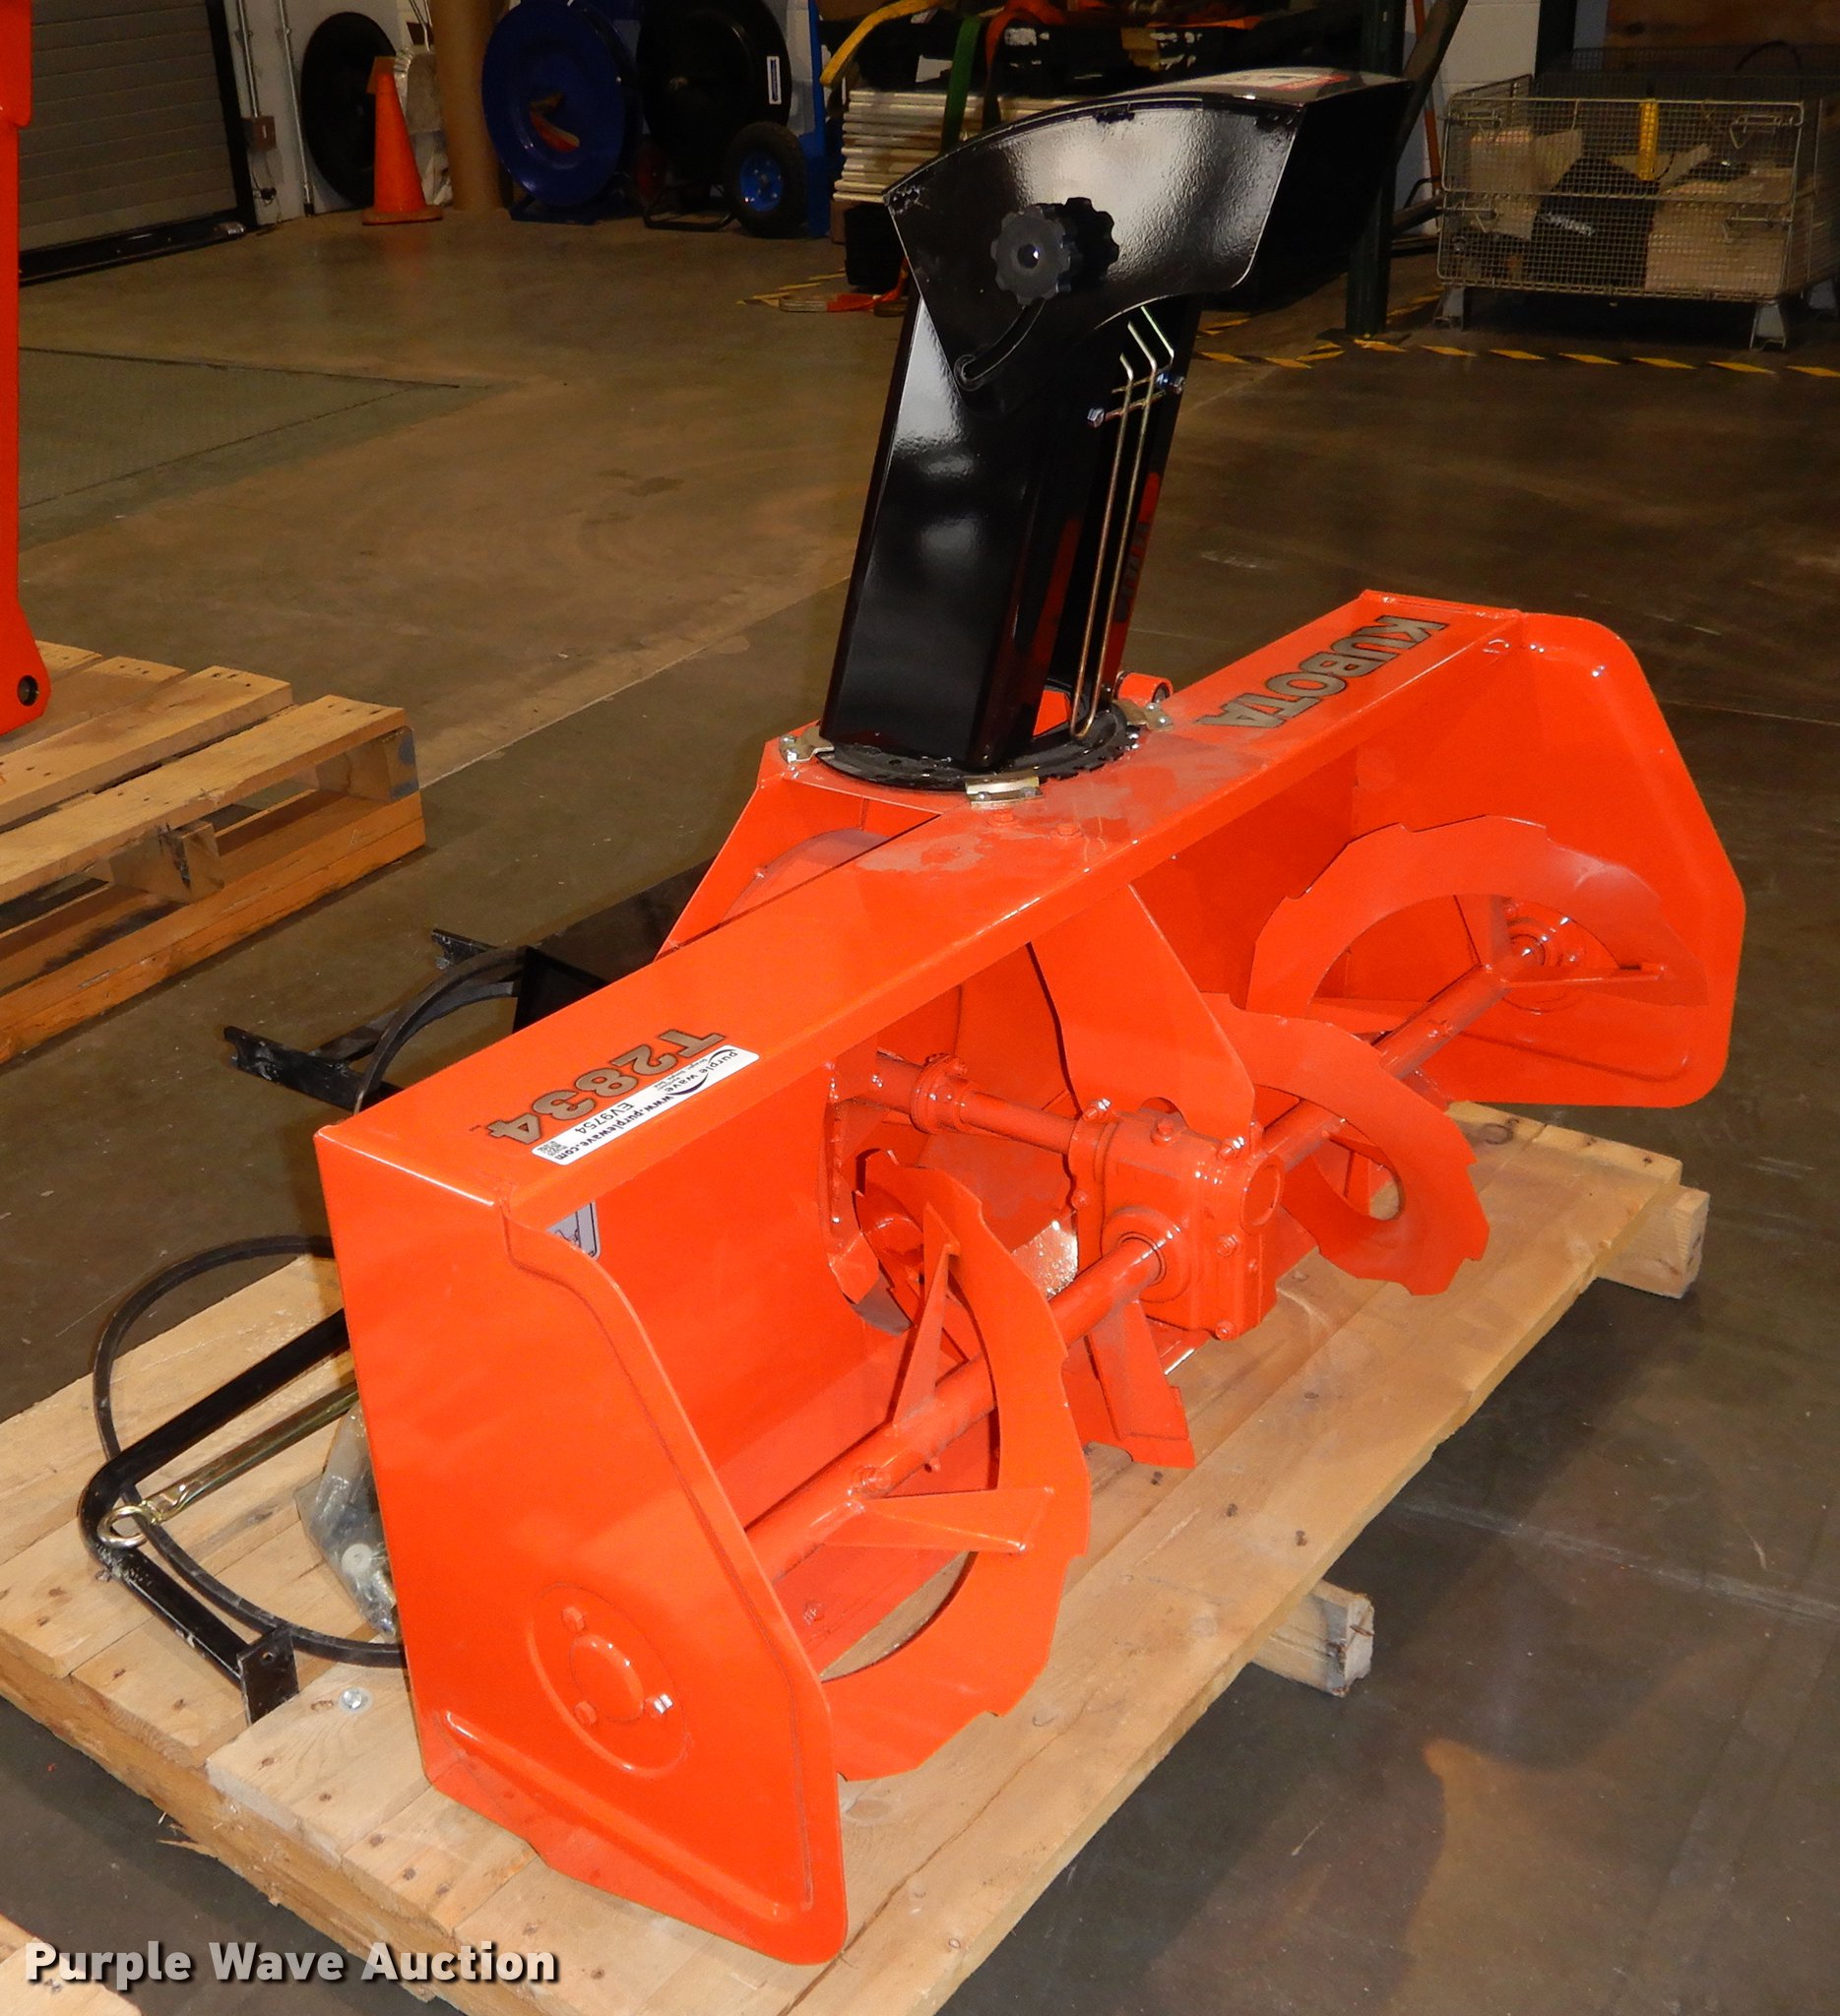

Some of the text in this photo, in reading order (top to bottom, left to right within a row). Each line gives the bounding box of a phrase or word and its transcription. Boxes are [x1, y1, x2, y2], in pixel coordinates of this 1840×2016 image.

[1194, 615, 1448, 727] KUBOTA
[665, 1074, 698, 1092] wave
[699, 1051, 737, 1073] purple
[488, 1030, 725, 1144] T2834
[554, 1095, 673, 1160] www.purplewave.com
[575, 1102, 634, 1134] EV9754
